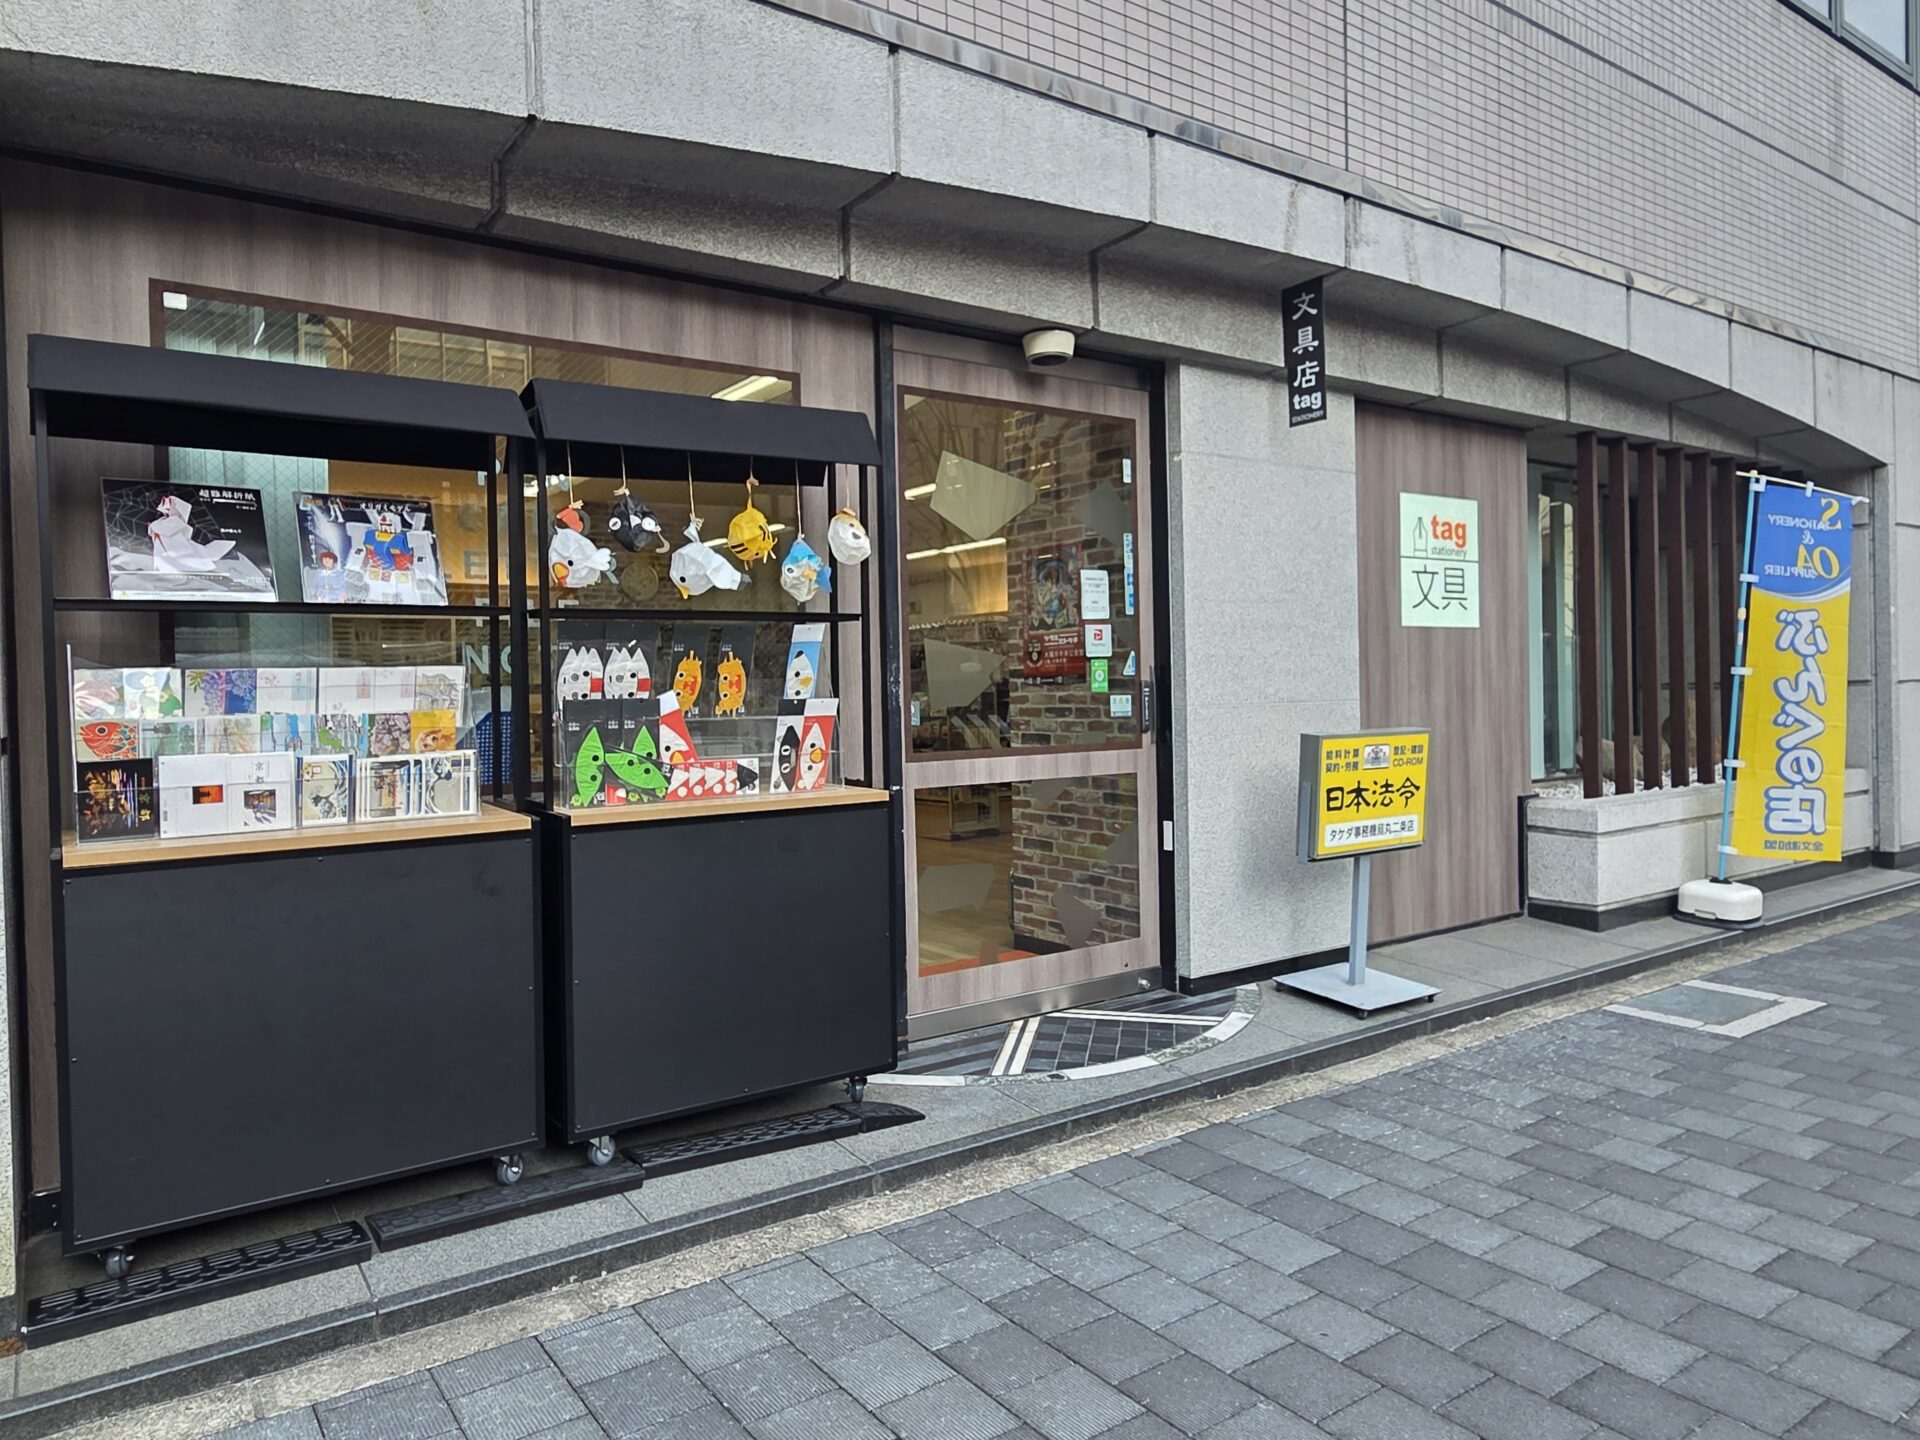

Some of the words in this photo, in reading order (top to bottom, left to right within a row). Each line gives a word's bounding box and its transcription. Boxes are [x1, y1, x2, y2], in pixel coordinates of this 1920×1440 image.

[1292, 292, 1320, 389] 文具店
[1292, 391, 1322, 410] tag
[1291, 410, 1324, 424] STATIONERY
[1431, 515, 1467, 548] tag
[1431, 546, 1467, 560] stationery
[1412, 564, 1468, 611] 文具
[1393, 757, 1424, 768] CD-ROM
[1326, 777, 1421, 814] 日本法令
